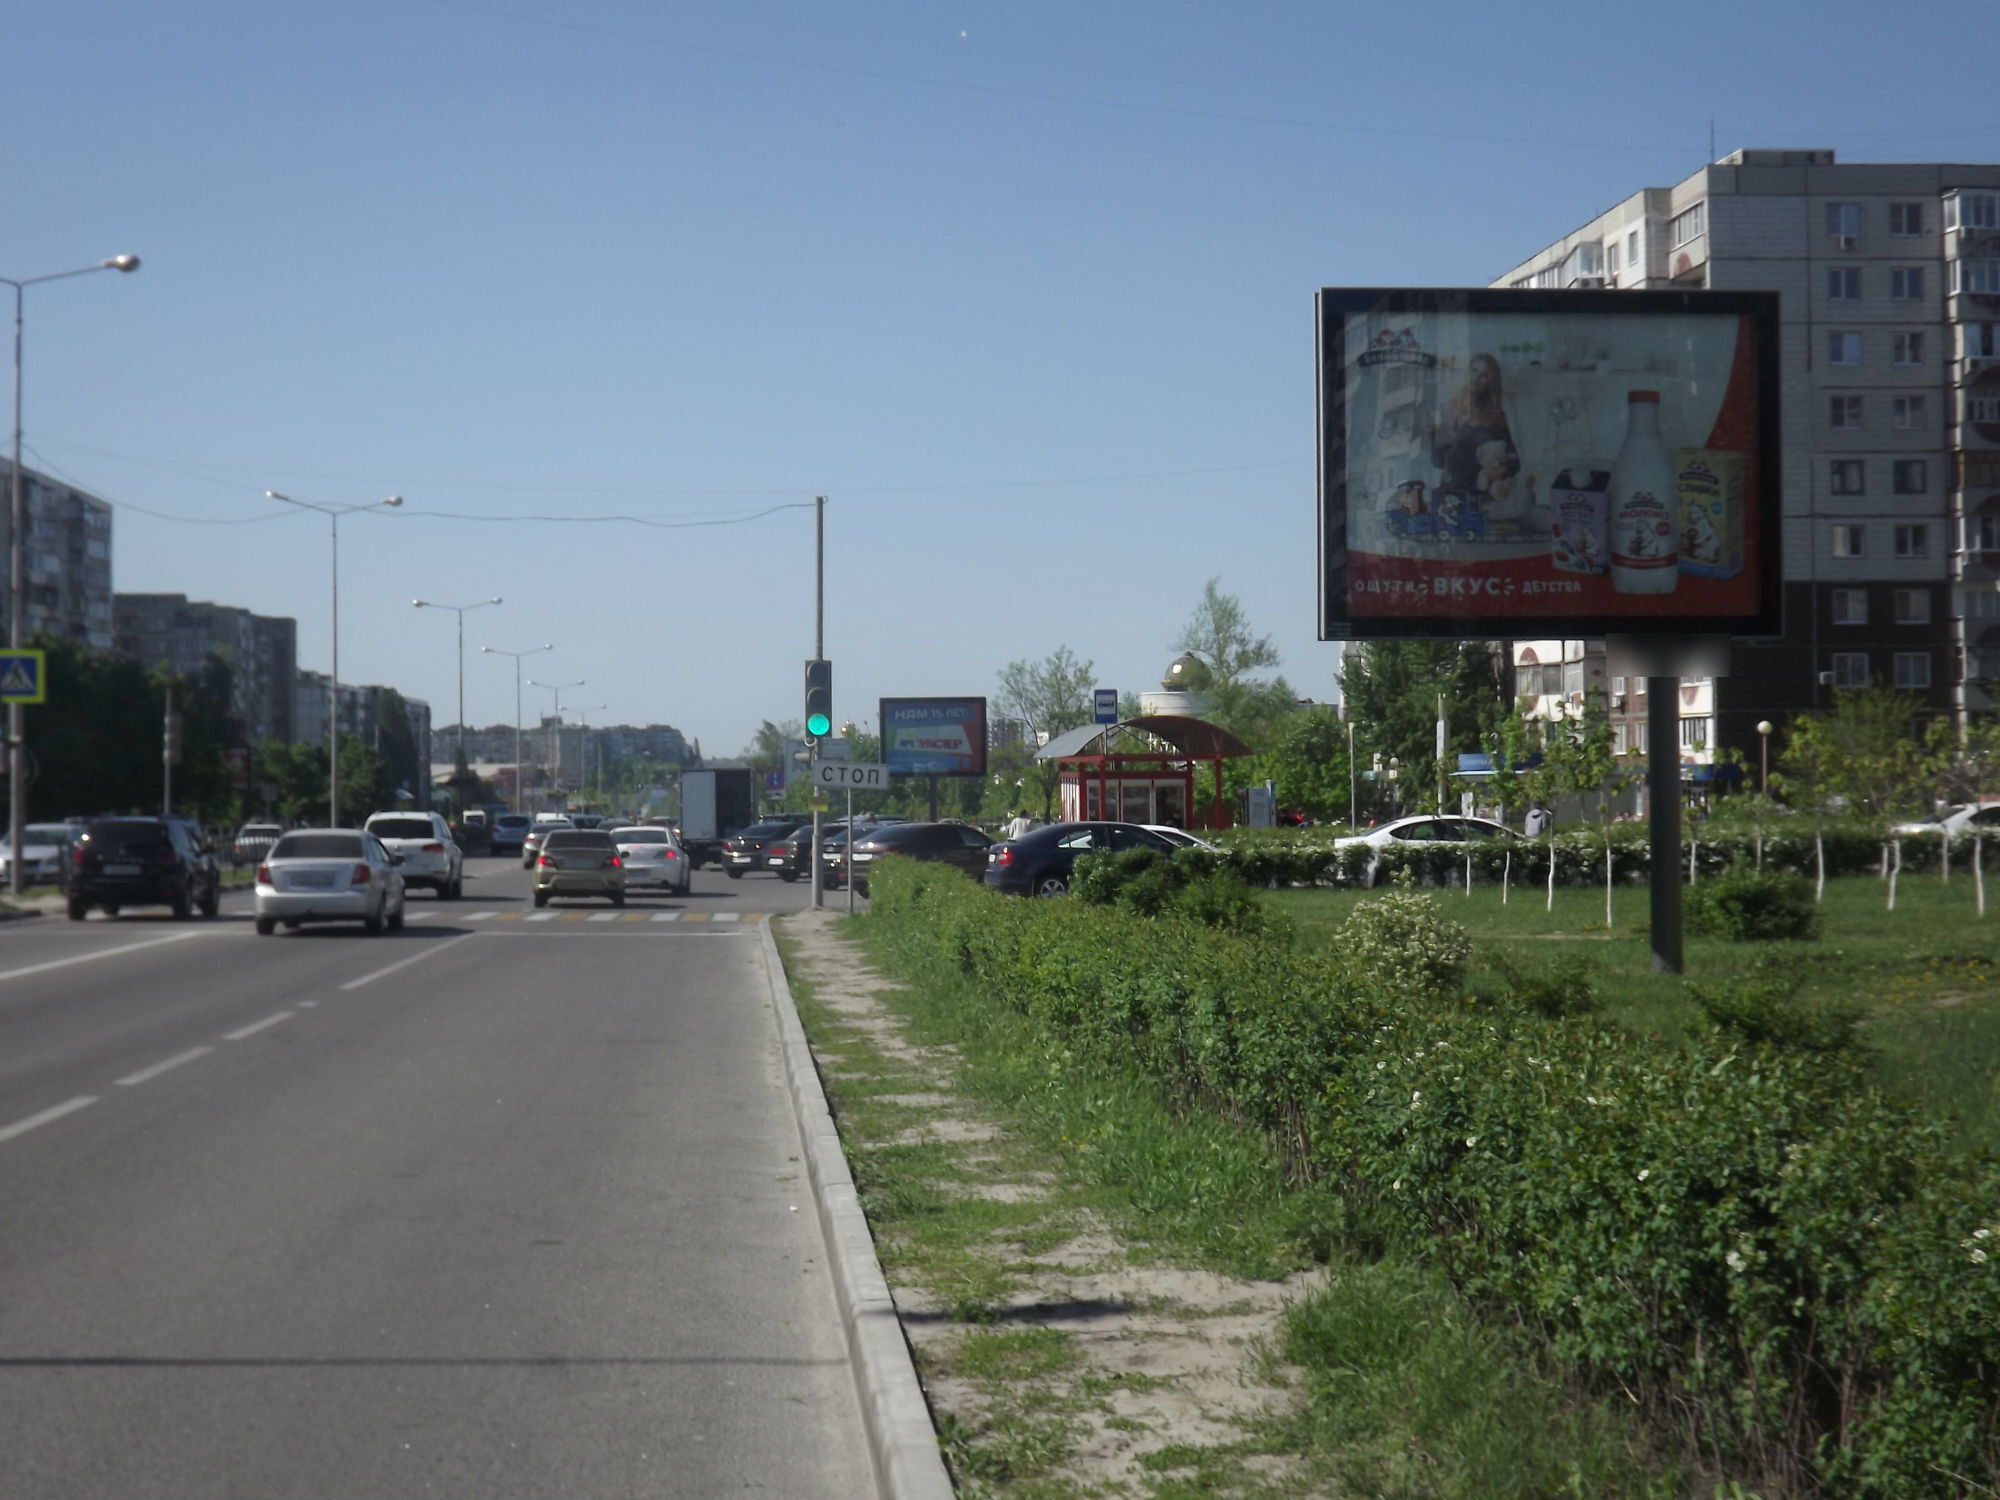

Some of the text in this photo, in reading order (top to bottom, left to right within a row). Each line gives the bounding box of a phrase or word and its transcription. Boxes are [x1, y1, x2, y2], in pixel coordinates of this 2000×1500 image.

[1619, 509, 1669, 520] МОЛОКО
[1355, 577, 1582, 595] ОЩУТИ ВКУС ДЕТСТВА
[894, 709, 928, 721] НАМ
[931, 709, 944, 718] 15
[822, 766, 880, 784] СТОП
